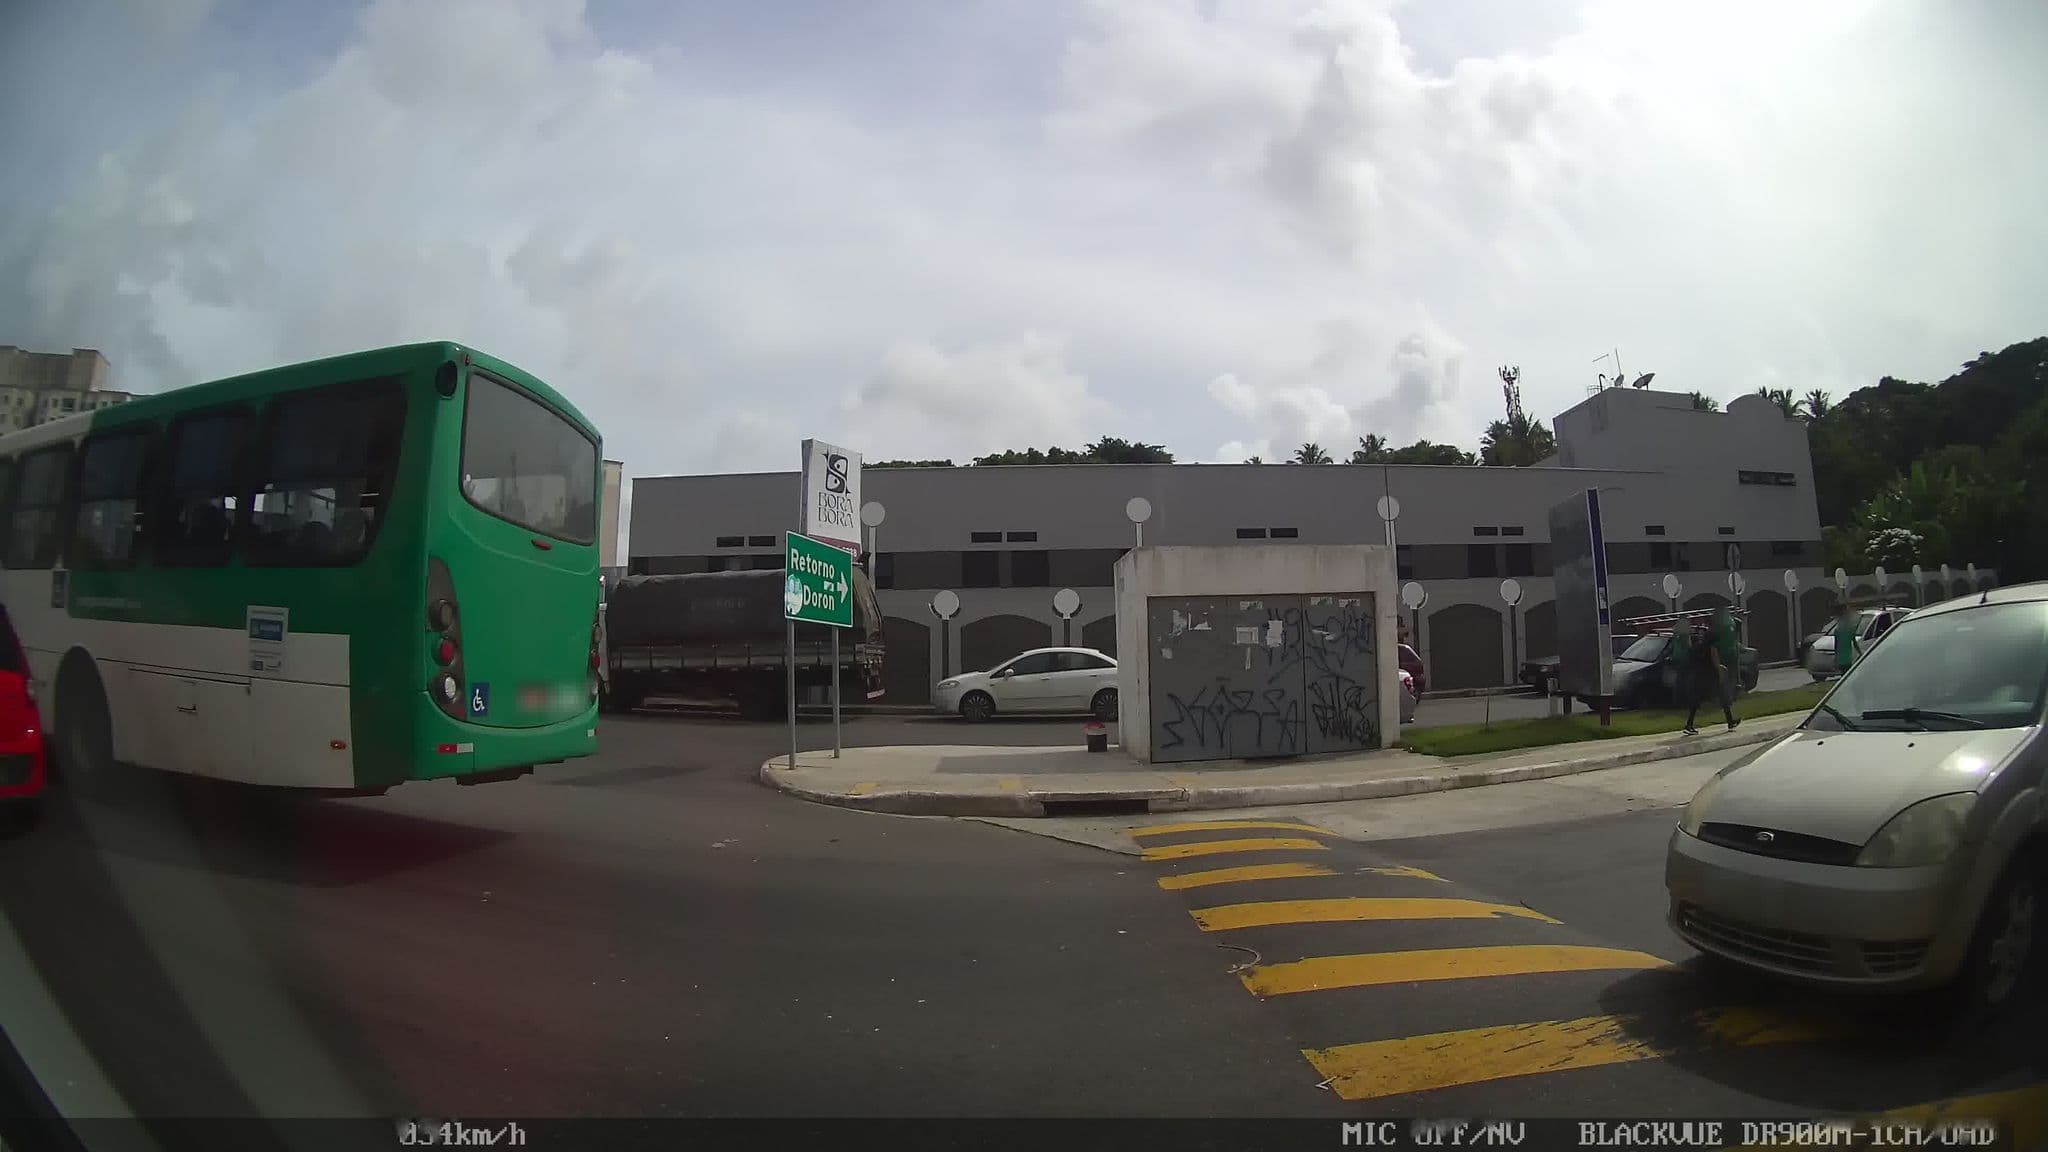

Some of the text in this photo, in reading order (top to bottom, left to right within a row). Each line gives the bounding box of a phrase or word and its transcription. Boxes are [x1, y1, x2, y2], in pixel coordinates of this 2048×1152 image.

[818, 492, 854, 514] BORA
[818, 507, 854, 529] BORA
[790, 547, 835, 580] Retorno
[803, 584, 835, 611] Doron
